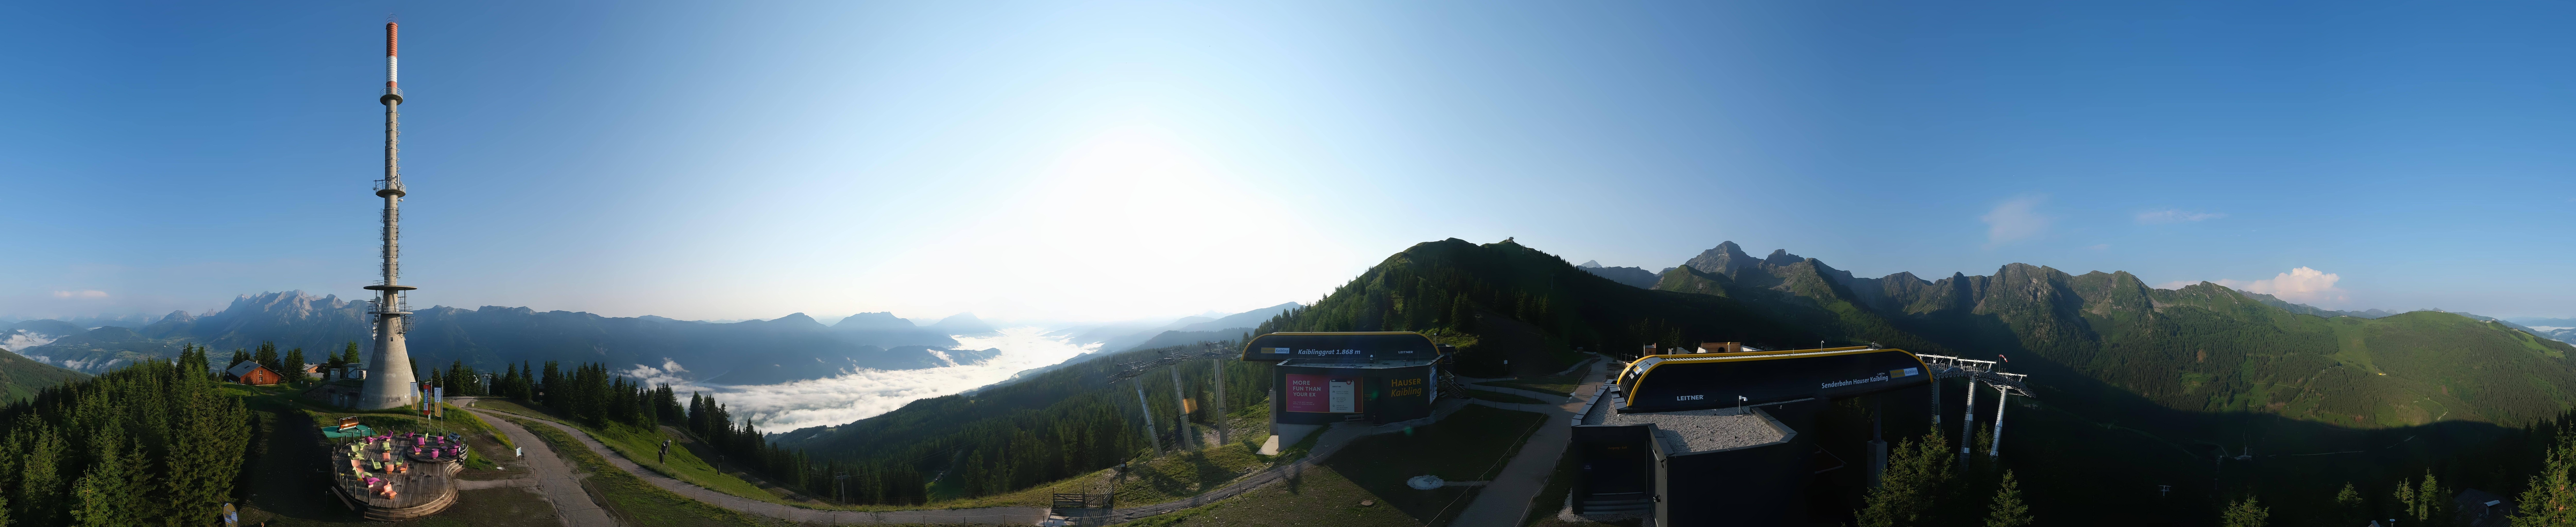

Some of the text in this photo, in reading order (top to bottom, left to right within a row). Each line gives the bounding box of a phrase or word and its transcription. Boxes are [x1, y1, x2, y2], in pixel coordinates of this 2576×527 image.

[1392, 378, 1421, 387] HAUSER
[1822, 380, 1852, 389] Senderbahn
[1391, 387, 1421, 397] Kaibling
